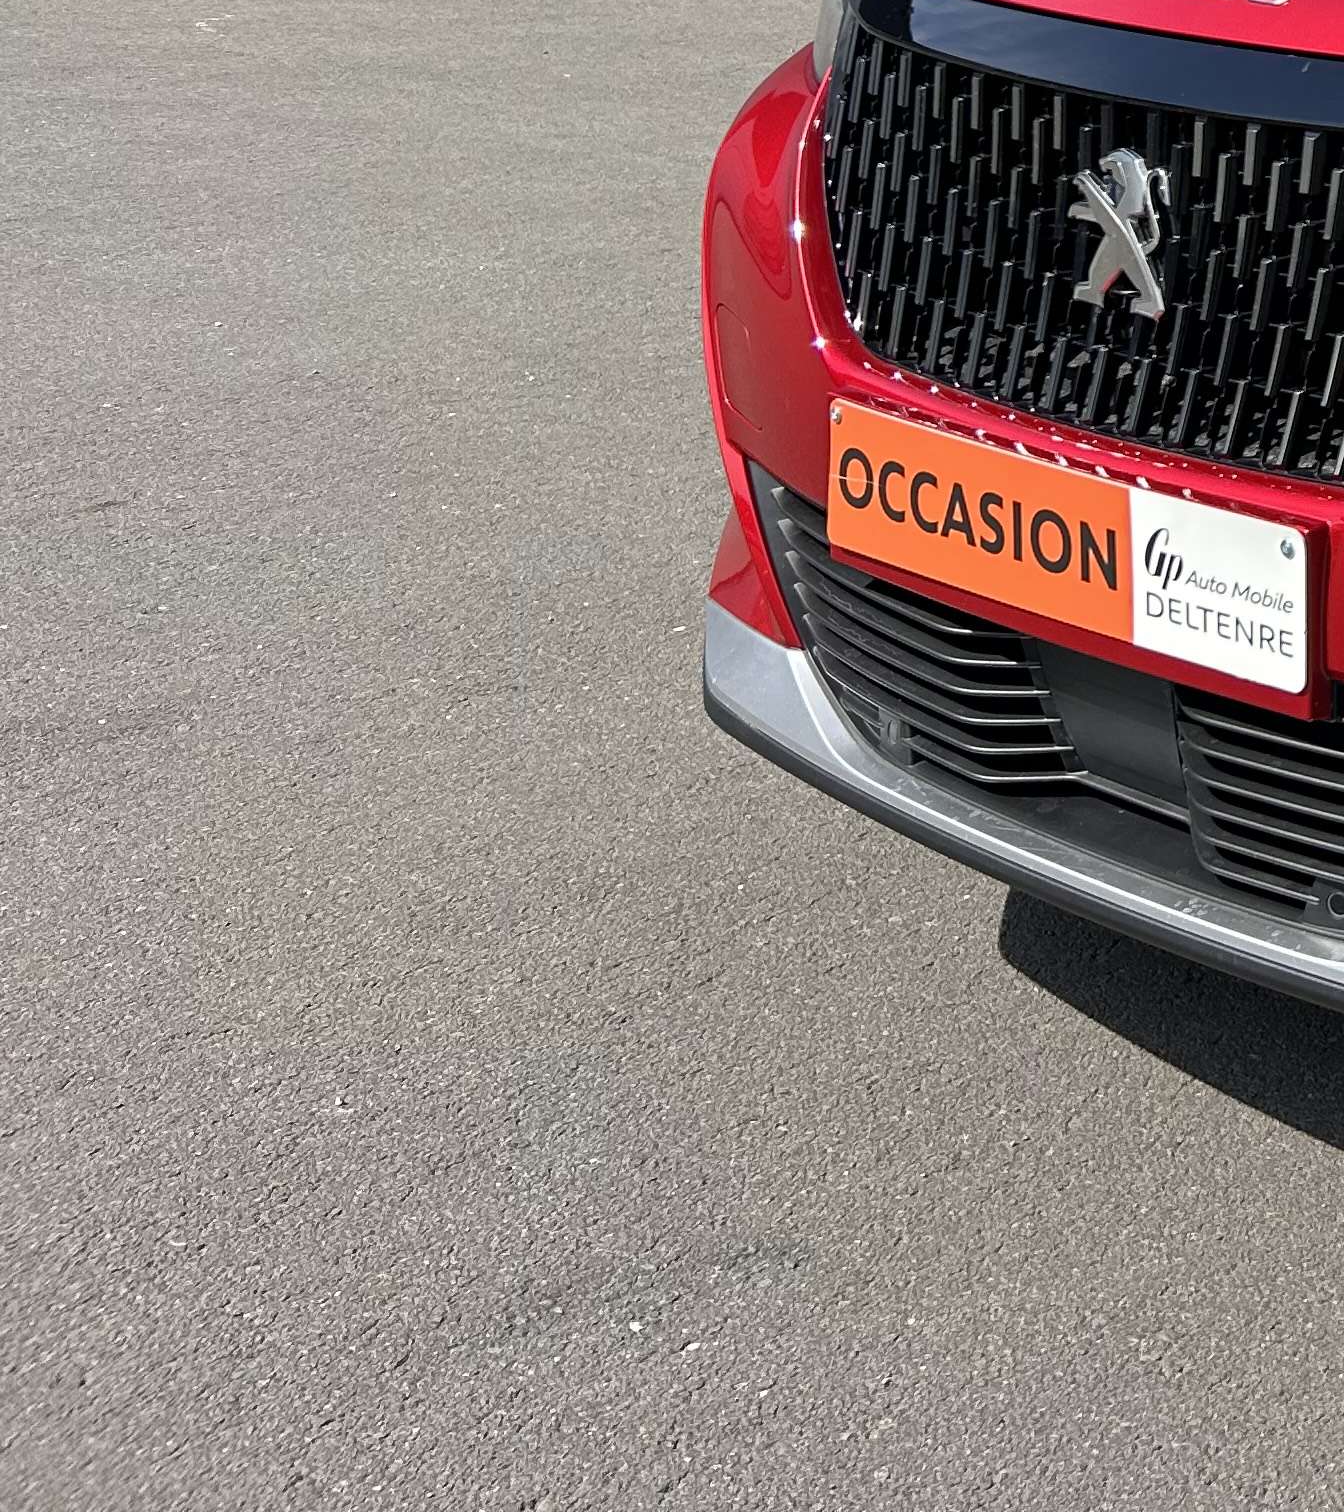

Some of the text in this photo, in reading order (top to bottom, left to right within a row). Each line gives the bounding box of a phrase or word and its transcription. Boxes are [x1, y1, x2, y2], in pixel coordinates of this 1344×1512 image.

[838, 447, 1119, 591] OCCASION
[1145, 592, 1295, 659] DELTENRE
[1185, 570, 1228, 595] Auto
[1232, 581, 1295, 615] Mobile
